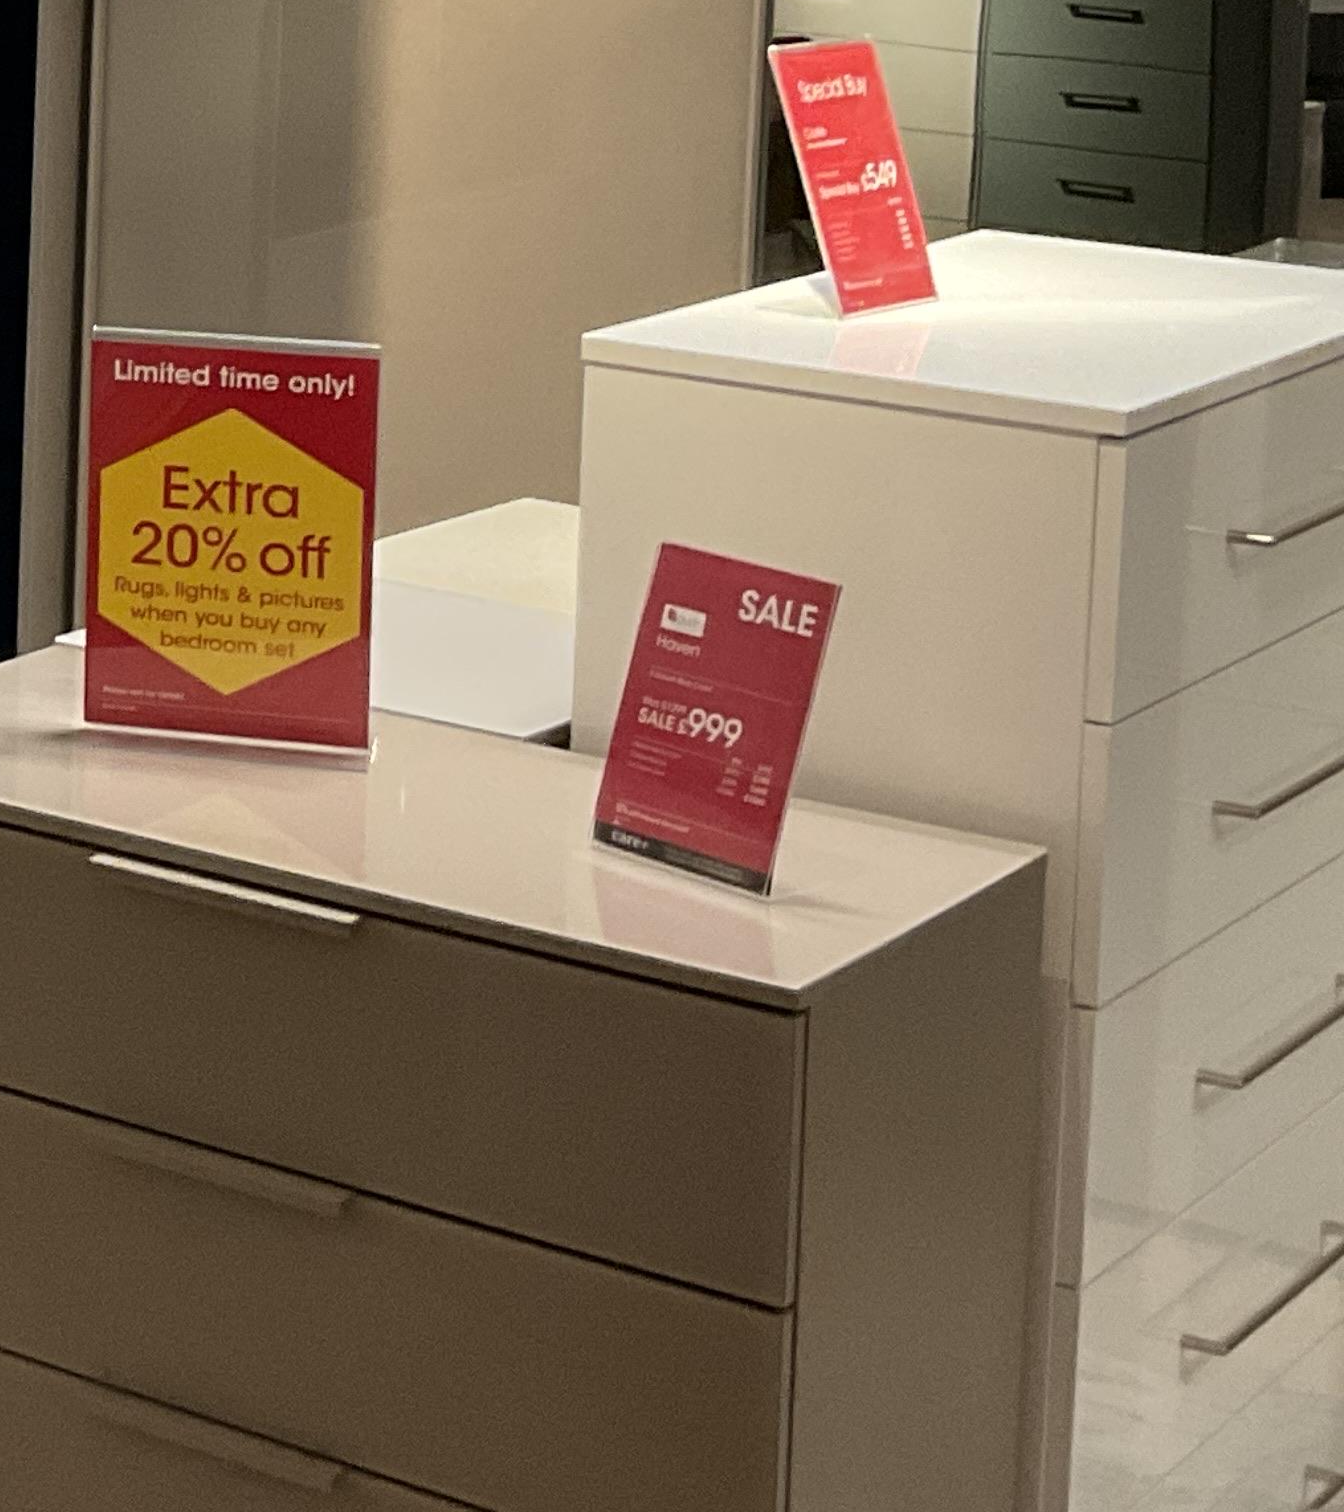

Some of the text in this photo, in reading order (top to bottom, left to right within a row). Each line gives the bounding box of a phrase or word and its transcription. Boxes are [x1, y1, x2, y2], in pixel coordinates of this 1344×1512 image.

[114, 358, 355, 401] Limited time only!
[162, 464, 299, 519] Extra
[131, 520, 333, 580] 20% off
[175, 580, 230, 603] lights
[238, 585, 251, 602] &
[259, 590, 344, 613] pictures
[738, 589, 819, 637] SALE
[130, 604, 326, 639] when you buy any
[160, 631, 295, 659] bedroom set
[655, 634, 701, 658] Haven
[638, 707, 743, 748] SALE £999
